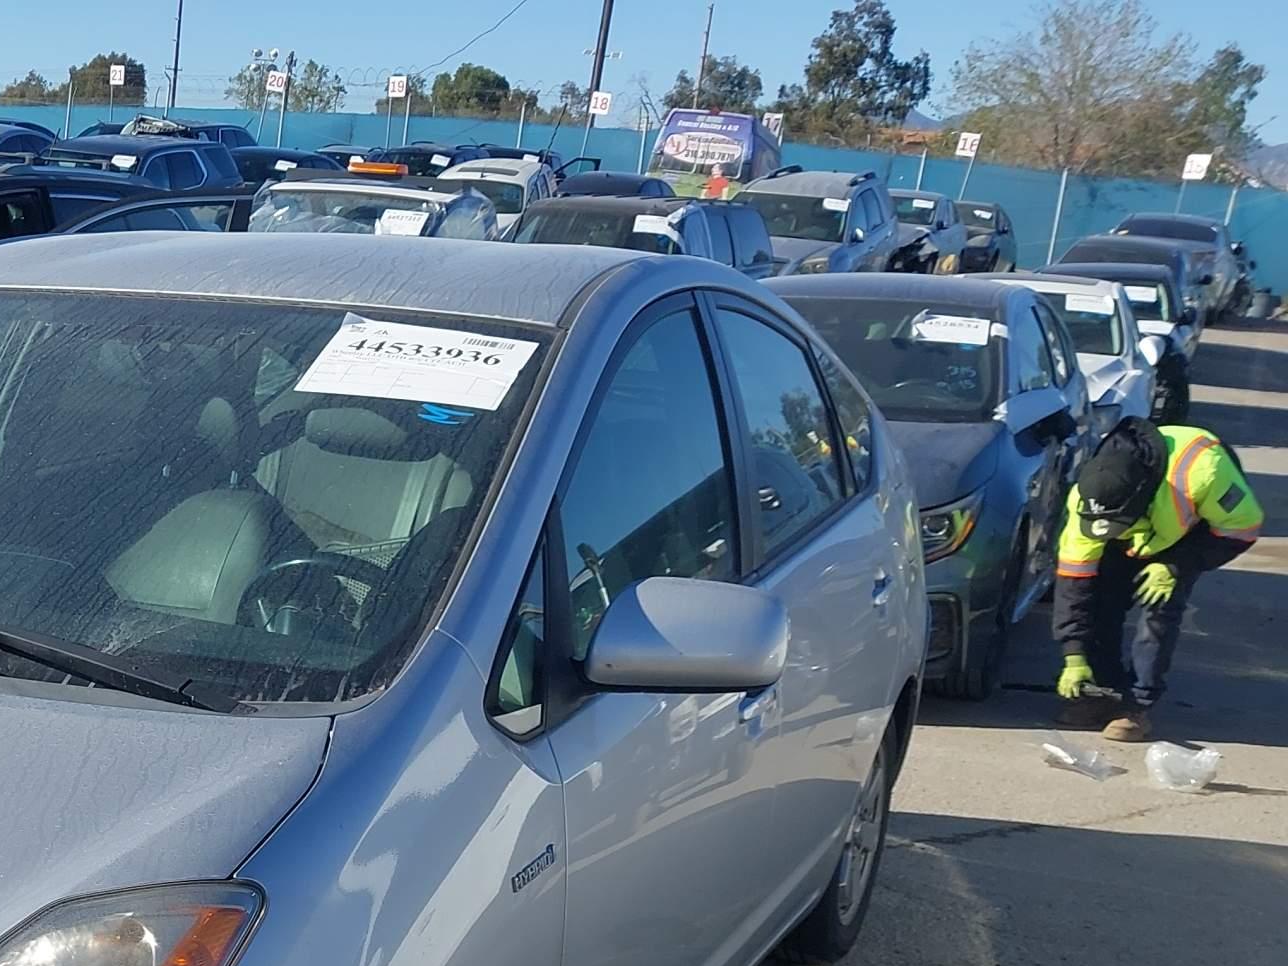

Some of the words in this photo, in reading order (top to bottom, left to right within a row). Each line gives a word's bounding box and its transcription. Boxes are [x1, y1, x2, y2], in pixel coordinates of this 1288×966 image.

[111, 69, 123, 81] 21
[268, 74, 284, 88] 20
[390, 80, 404, 93] 19
[592, 96, 609, 111] 18
[764, 117, 780, 134] 17
[959, 137, 979, 152] 16
[347, 338, 505, 366] 44533936
[511, 843, 555, 893] HYBRID
